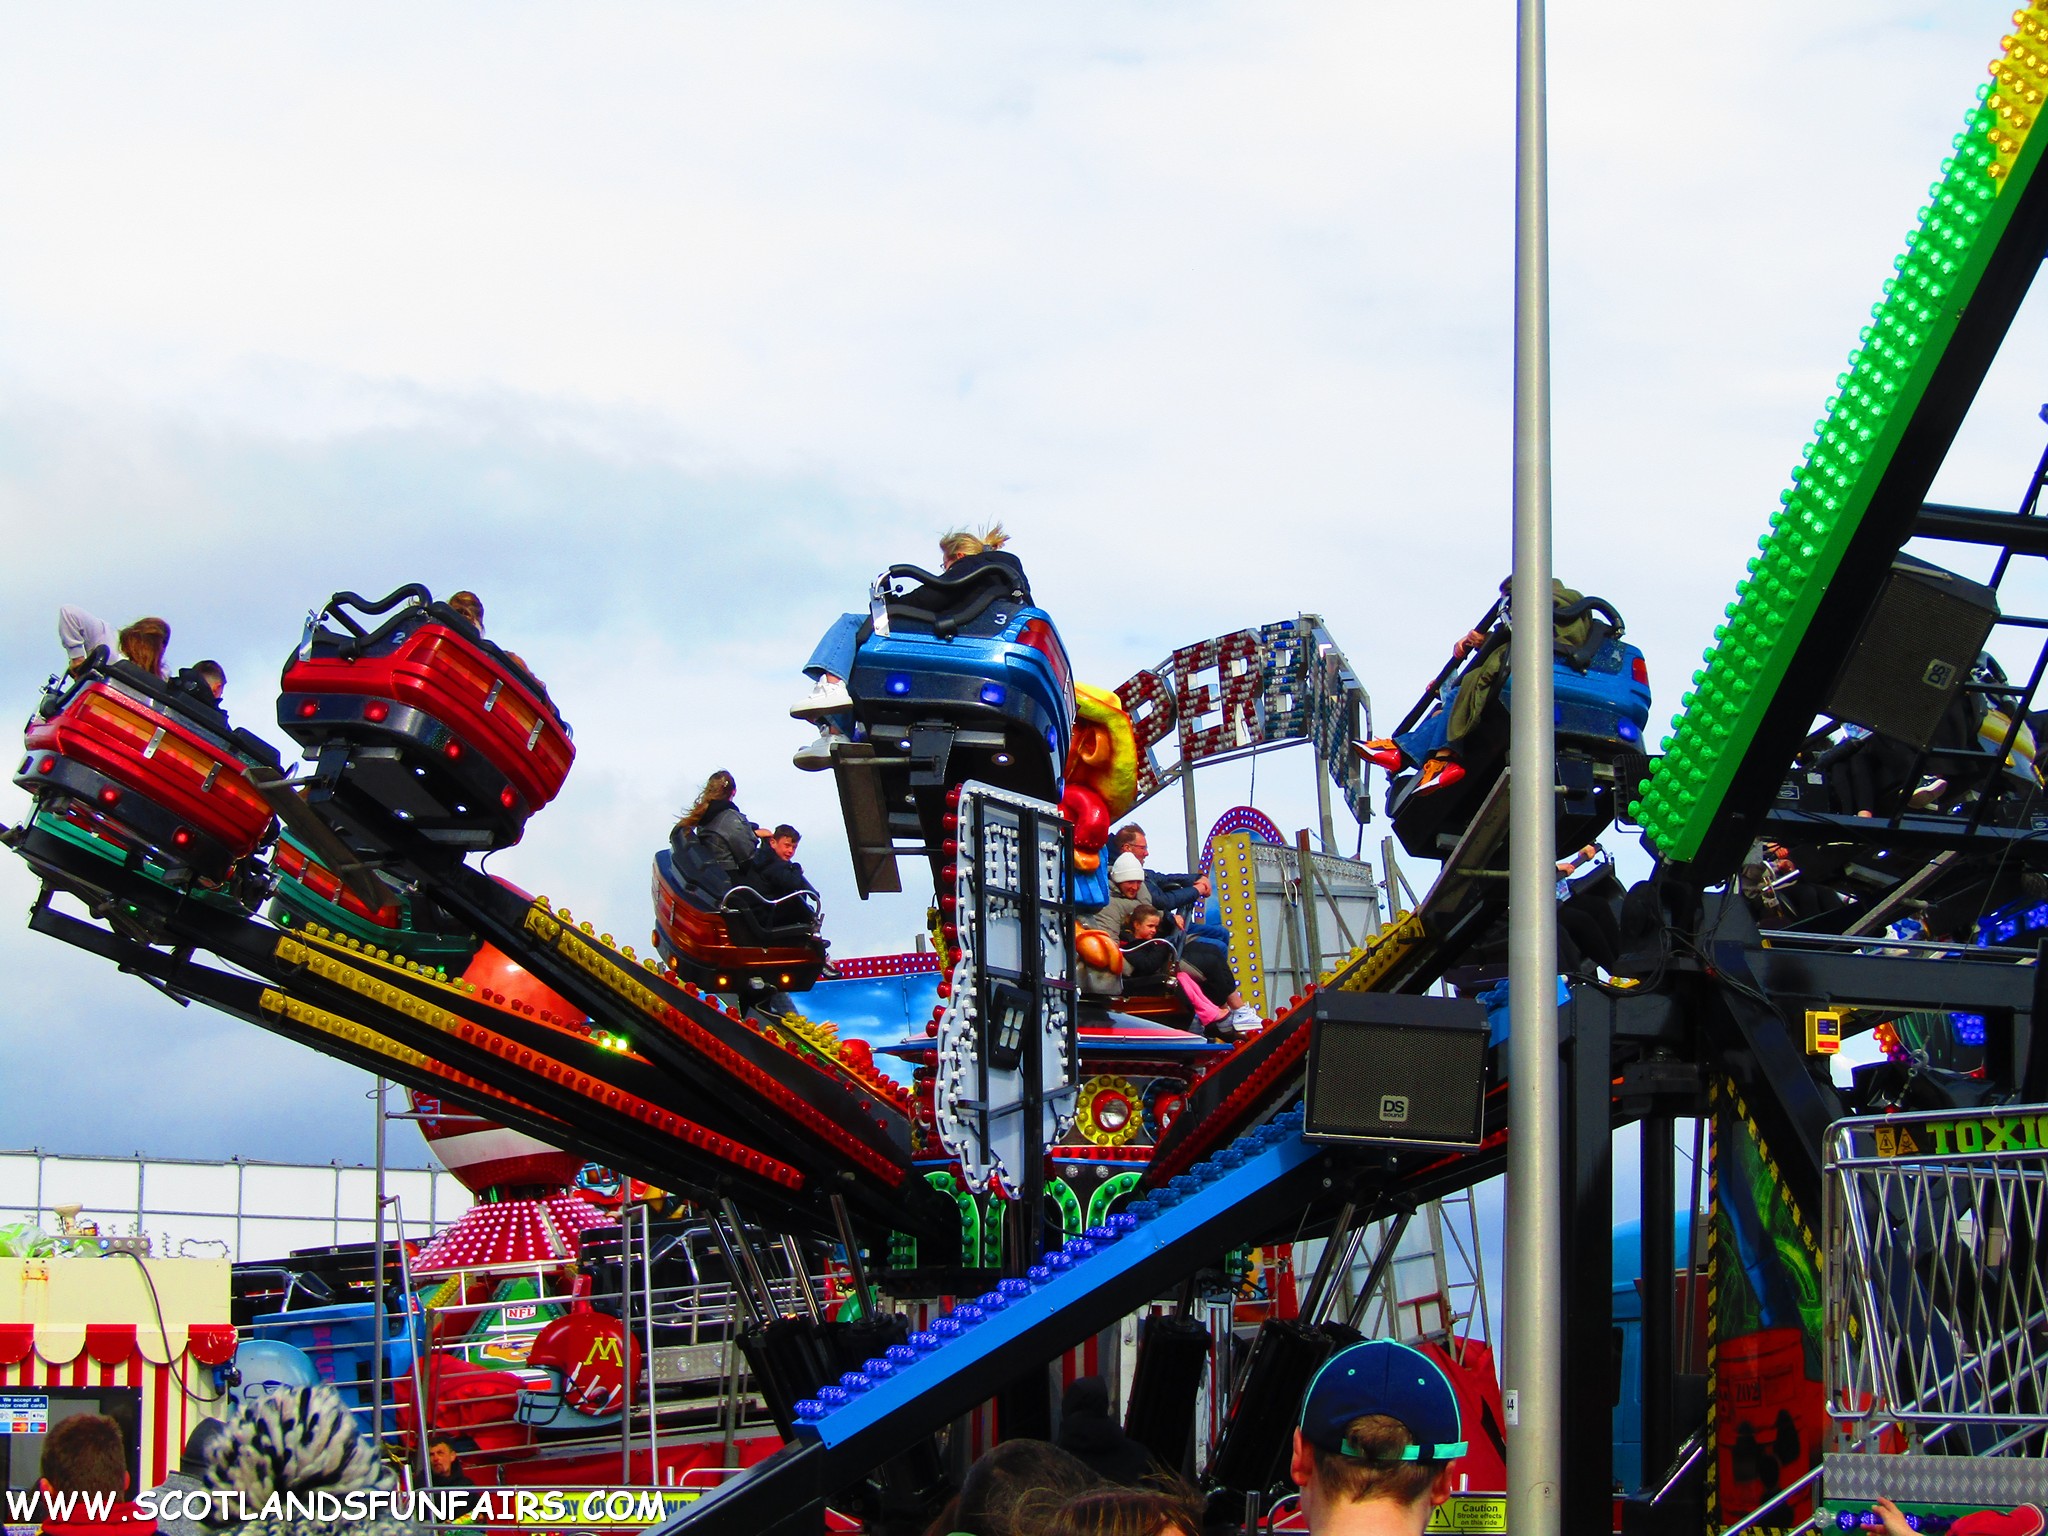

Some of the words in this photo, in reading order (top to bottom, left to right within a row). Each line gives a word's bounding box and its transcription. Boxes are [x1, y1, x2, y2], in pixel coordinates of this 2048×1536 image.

[994, 613, 1007, 625] 3
[392, 631, 405, 644] 2
[1928, 664, 1946, 684] DS
[1383, 1100, 1404, 1112] DS
[508, 1308, 535, 1318] NFL
[583, 1337, 624, 1367] M
[1462, 1503, 1498, 1512] Caution
